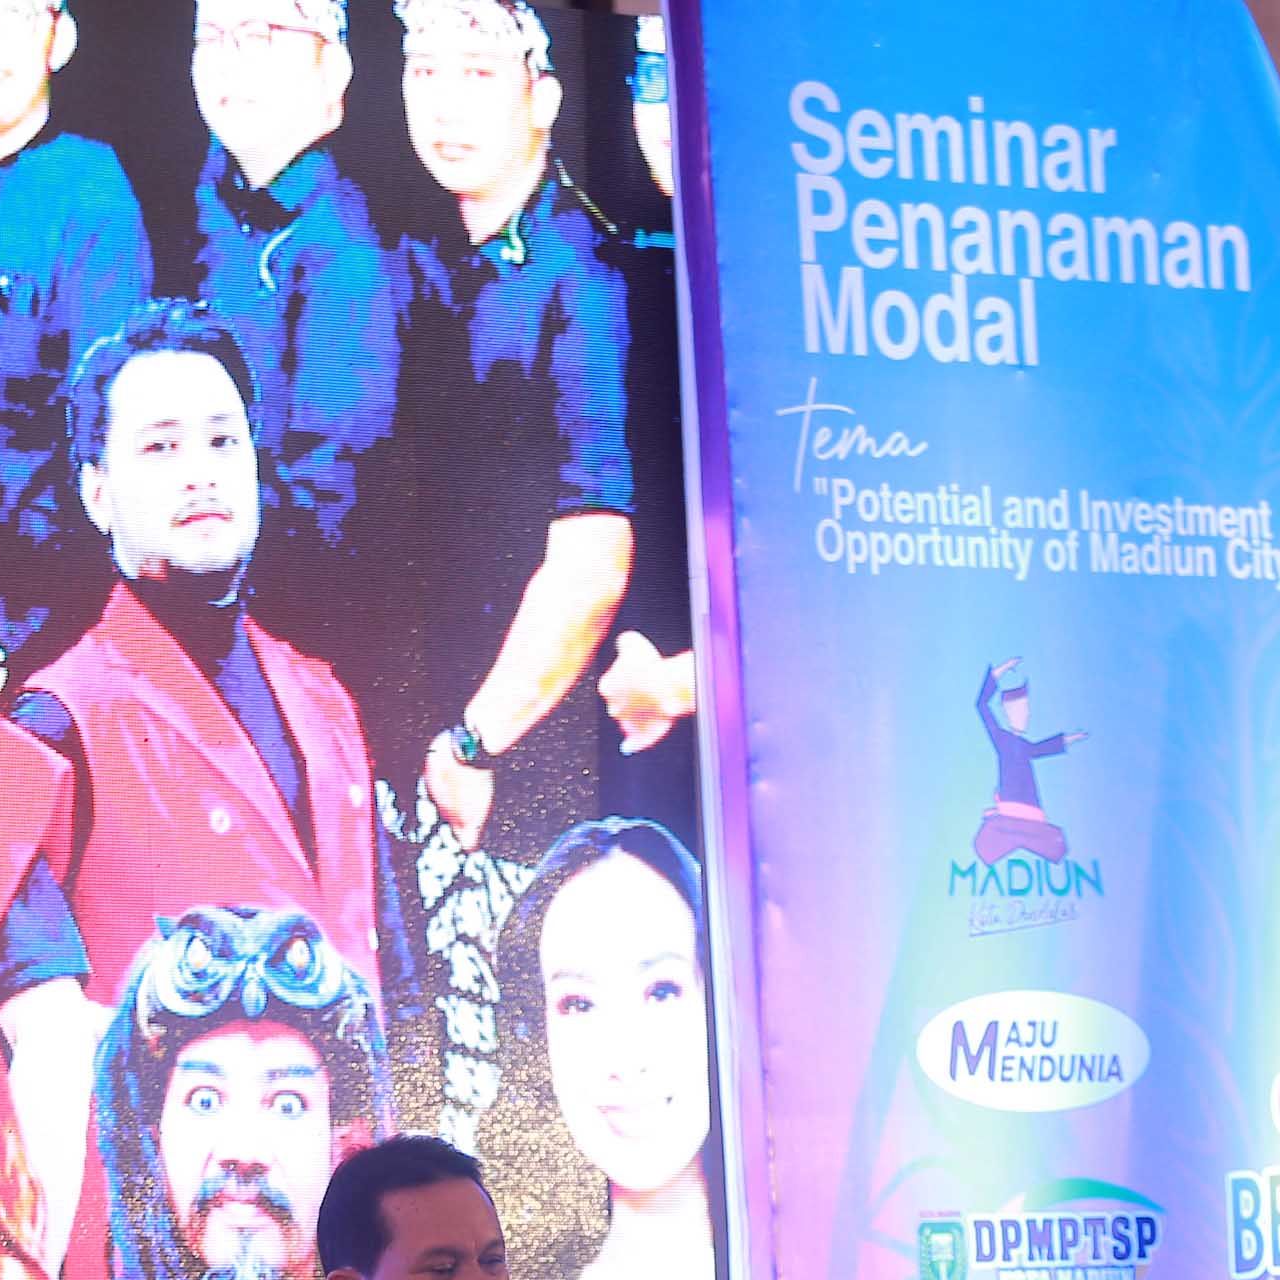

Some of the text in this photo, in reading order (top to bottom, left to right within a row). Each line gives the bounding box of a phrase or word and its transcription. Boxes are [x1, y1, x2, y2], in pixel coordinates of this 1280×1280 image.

[789, 81, 1116, 194] Seminar
[796, 174, 1251, 292] Penanaman
[801, 264, 1040, 367] Modal
[776, 377, 929, 494] Tema
[816, 518, 1034, 581] Opportunity
[1044, 530, 1078, 572] of
[1090, 532, 1218, 578] Madiun
[1003, 489, 1069, 529] and
[1080, 489, 1273, 540] Investment
[949, 858, 1105, 898] MADIUN
[973, 1216, 1157, 1263] DPMPTSP
